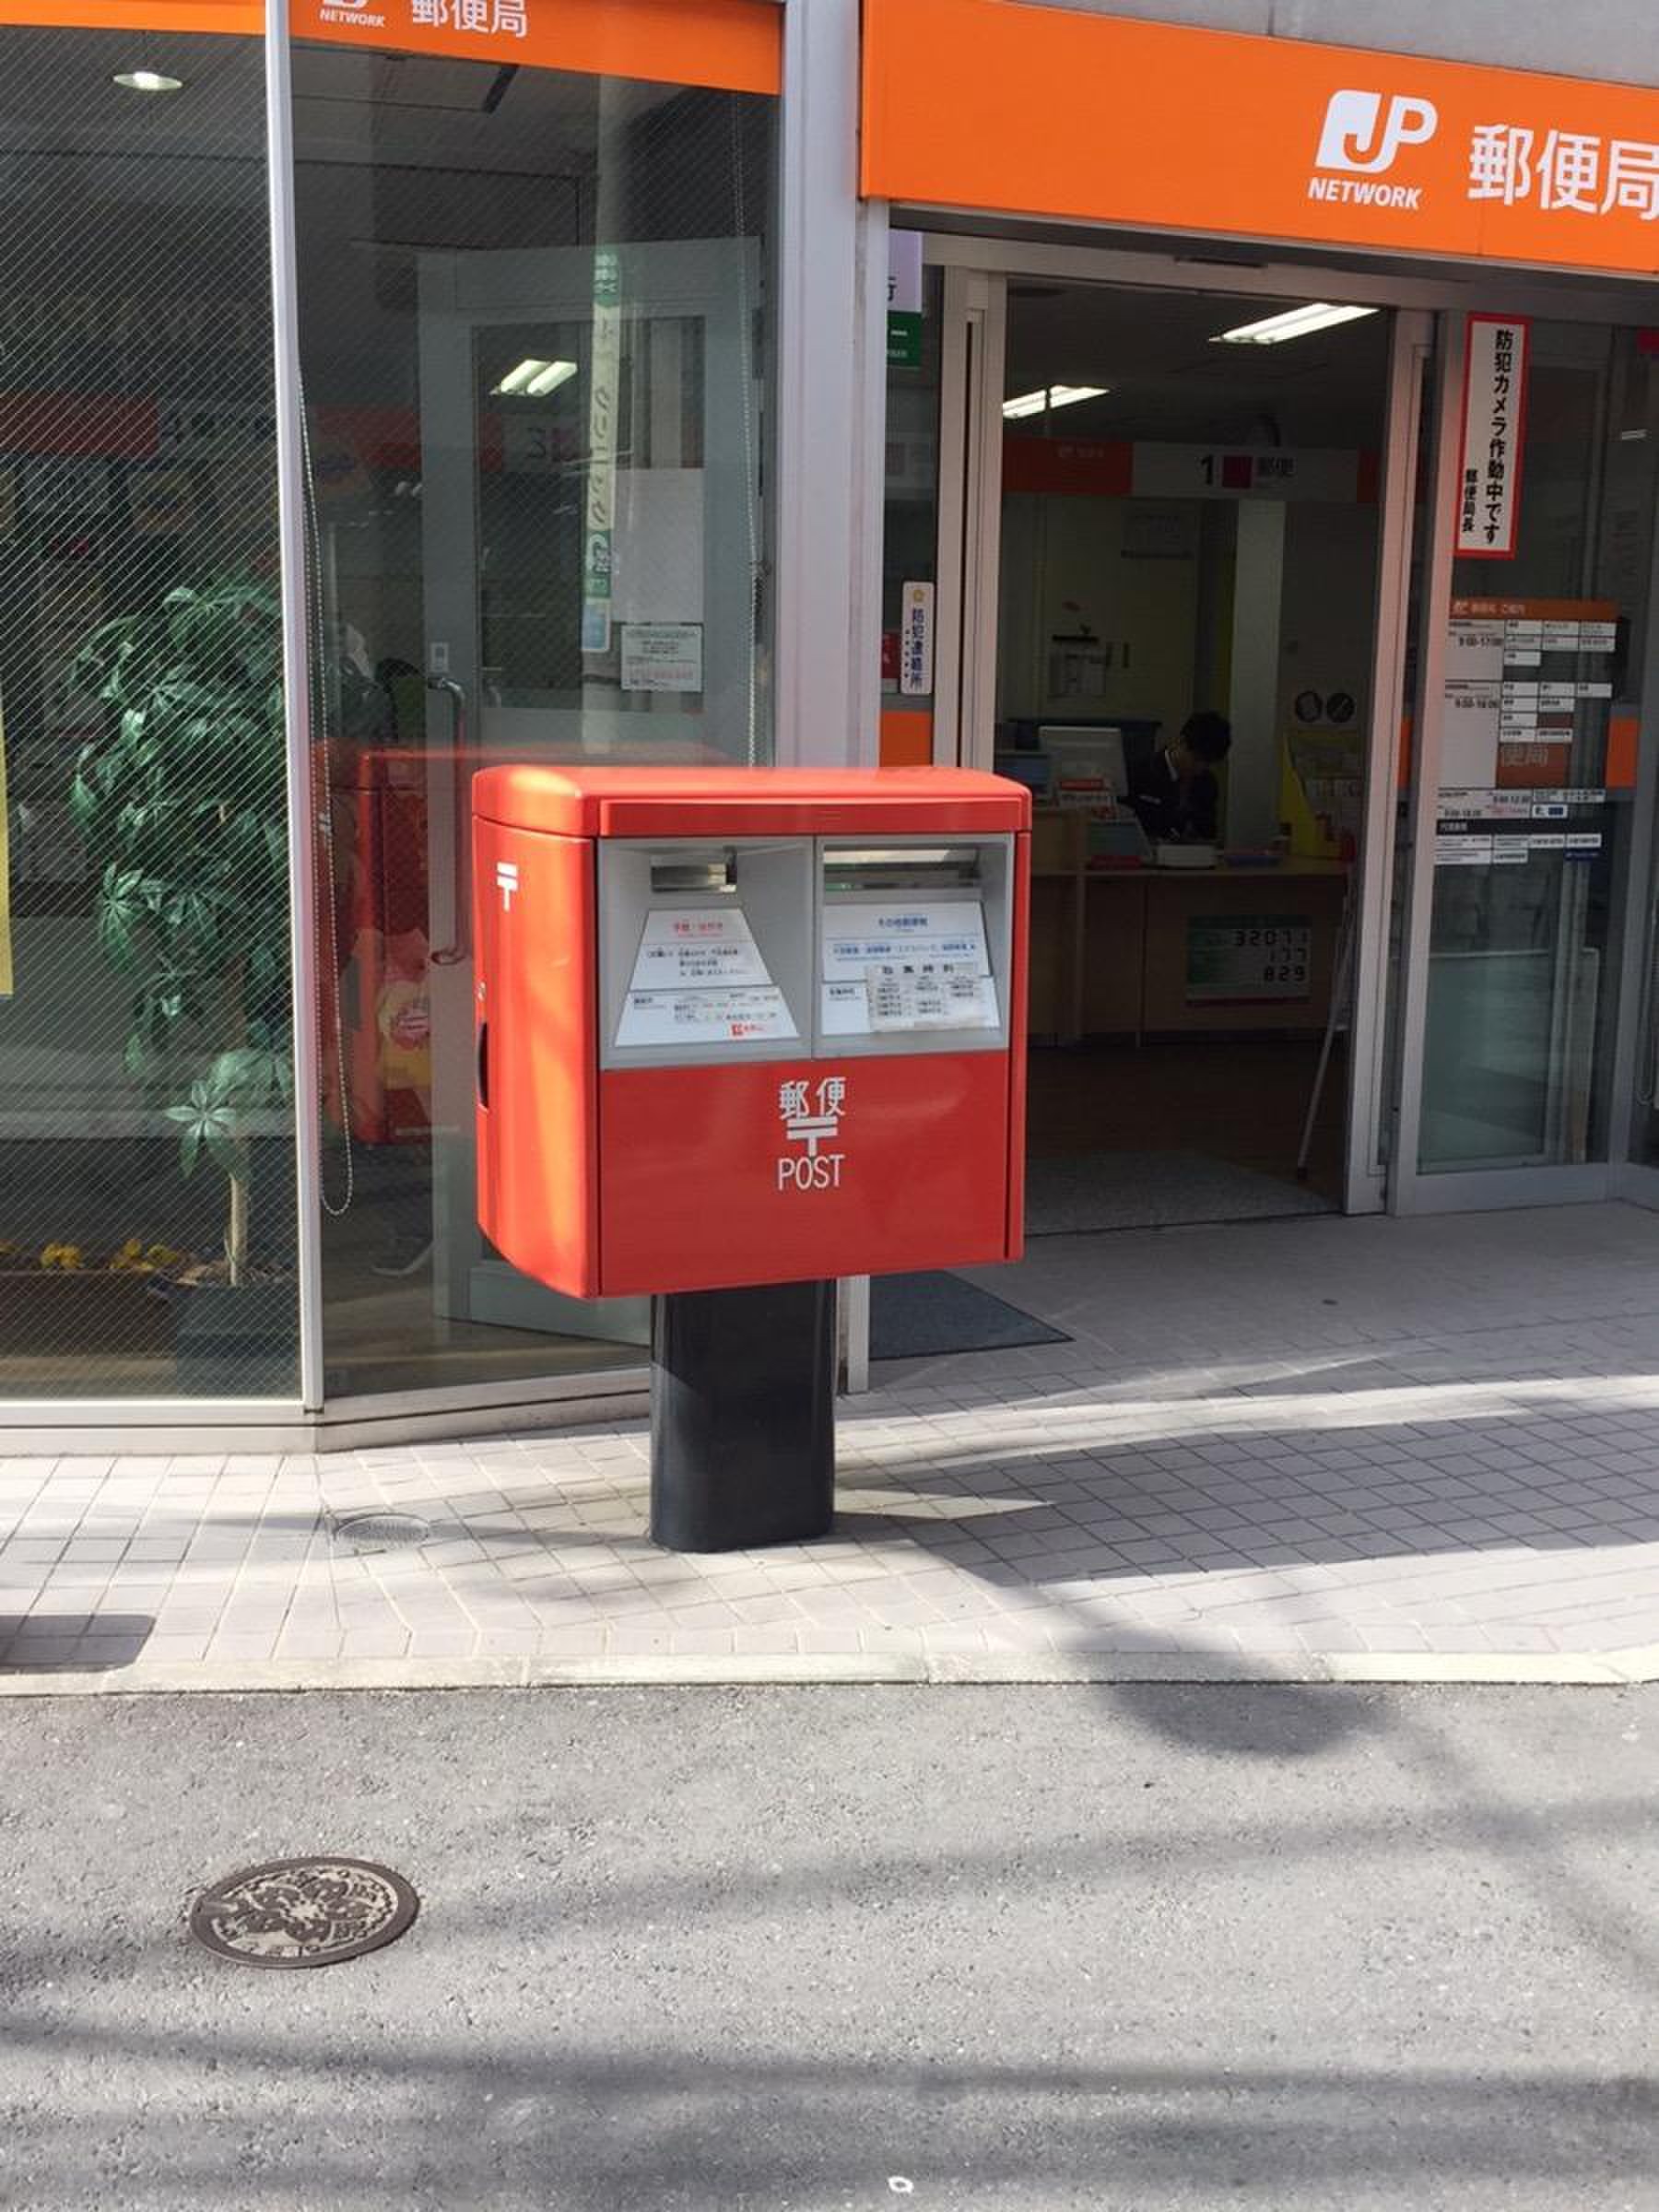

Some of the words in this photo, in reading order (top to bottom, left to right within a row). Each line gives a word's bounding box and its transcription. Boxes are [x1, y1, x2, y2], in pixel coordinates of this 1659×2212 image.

[319, 8, 385, 28] NETWORK
[412, 0, 528, 38] 郵便局
[1467, 124, 1659, 221] 郵便局
[1307, 176, 1423, 211] NETWORK
[1483, 329, 1514, 544] 防犯カメラ作動中です
[1201, 454, 1214, 486] 1
[779, 1076, 846, 1121] 郵便
[778, 1154, 846, 1191] POST
